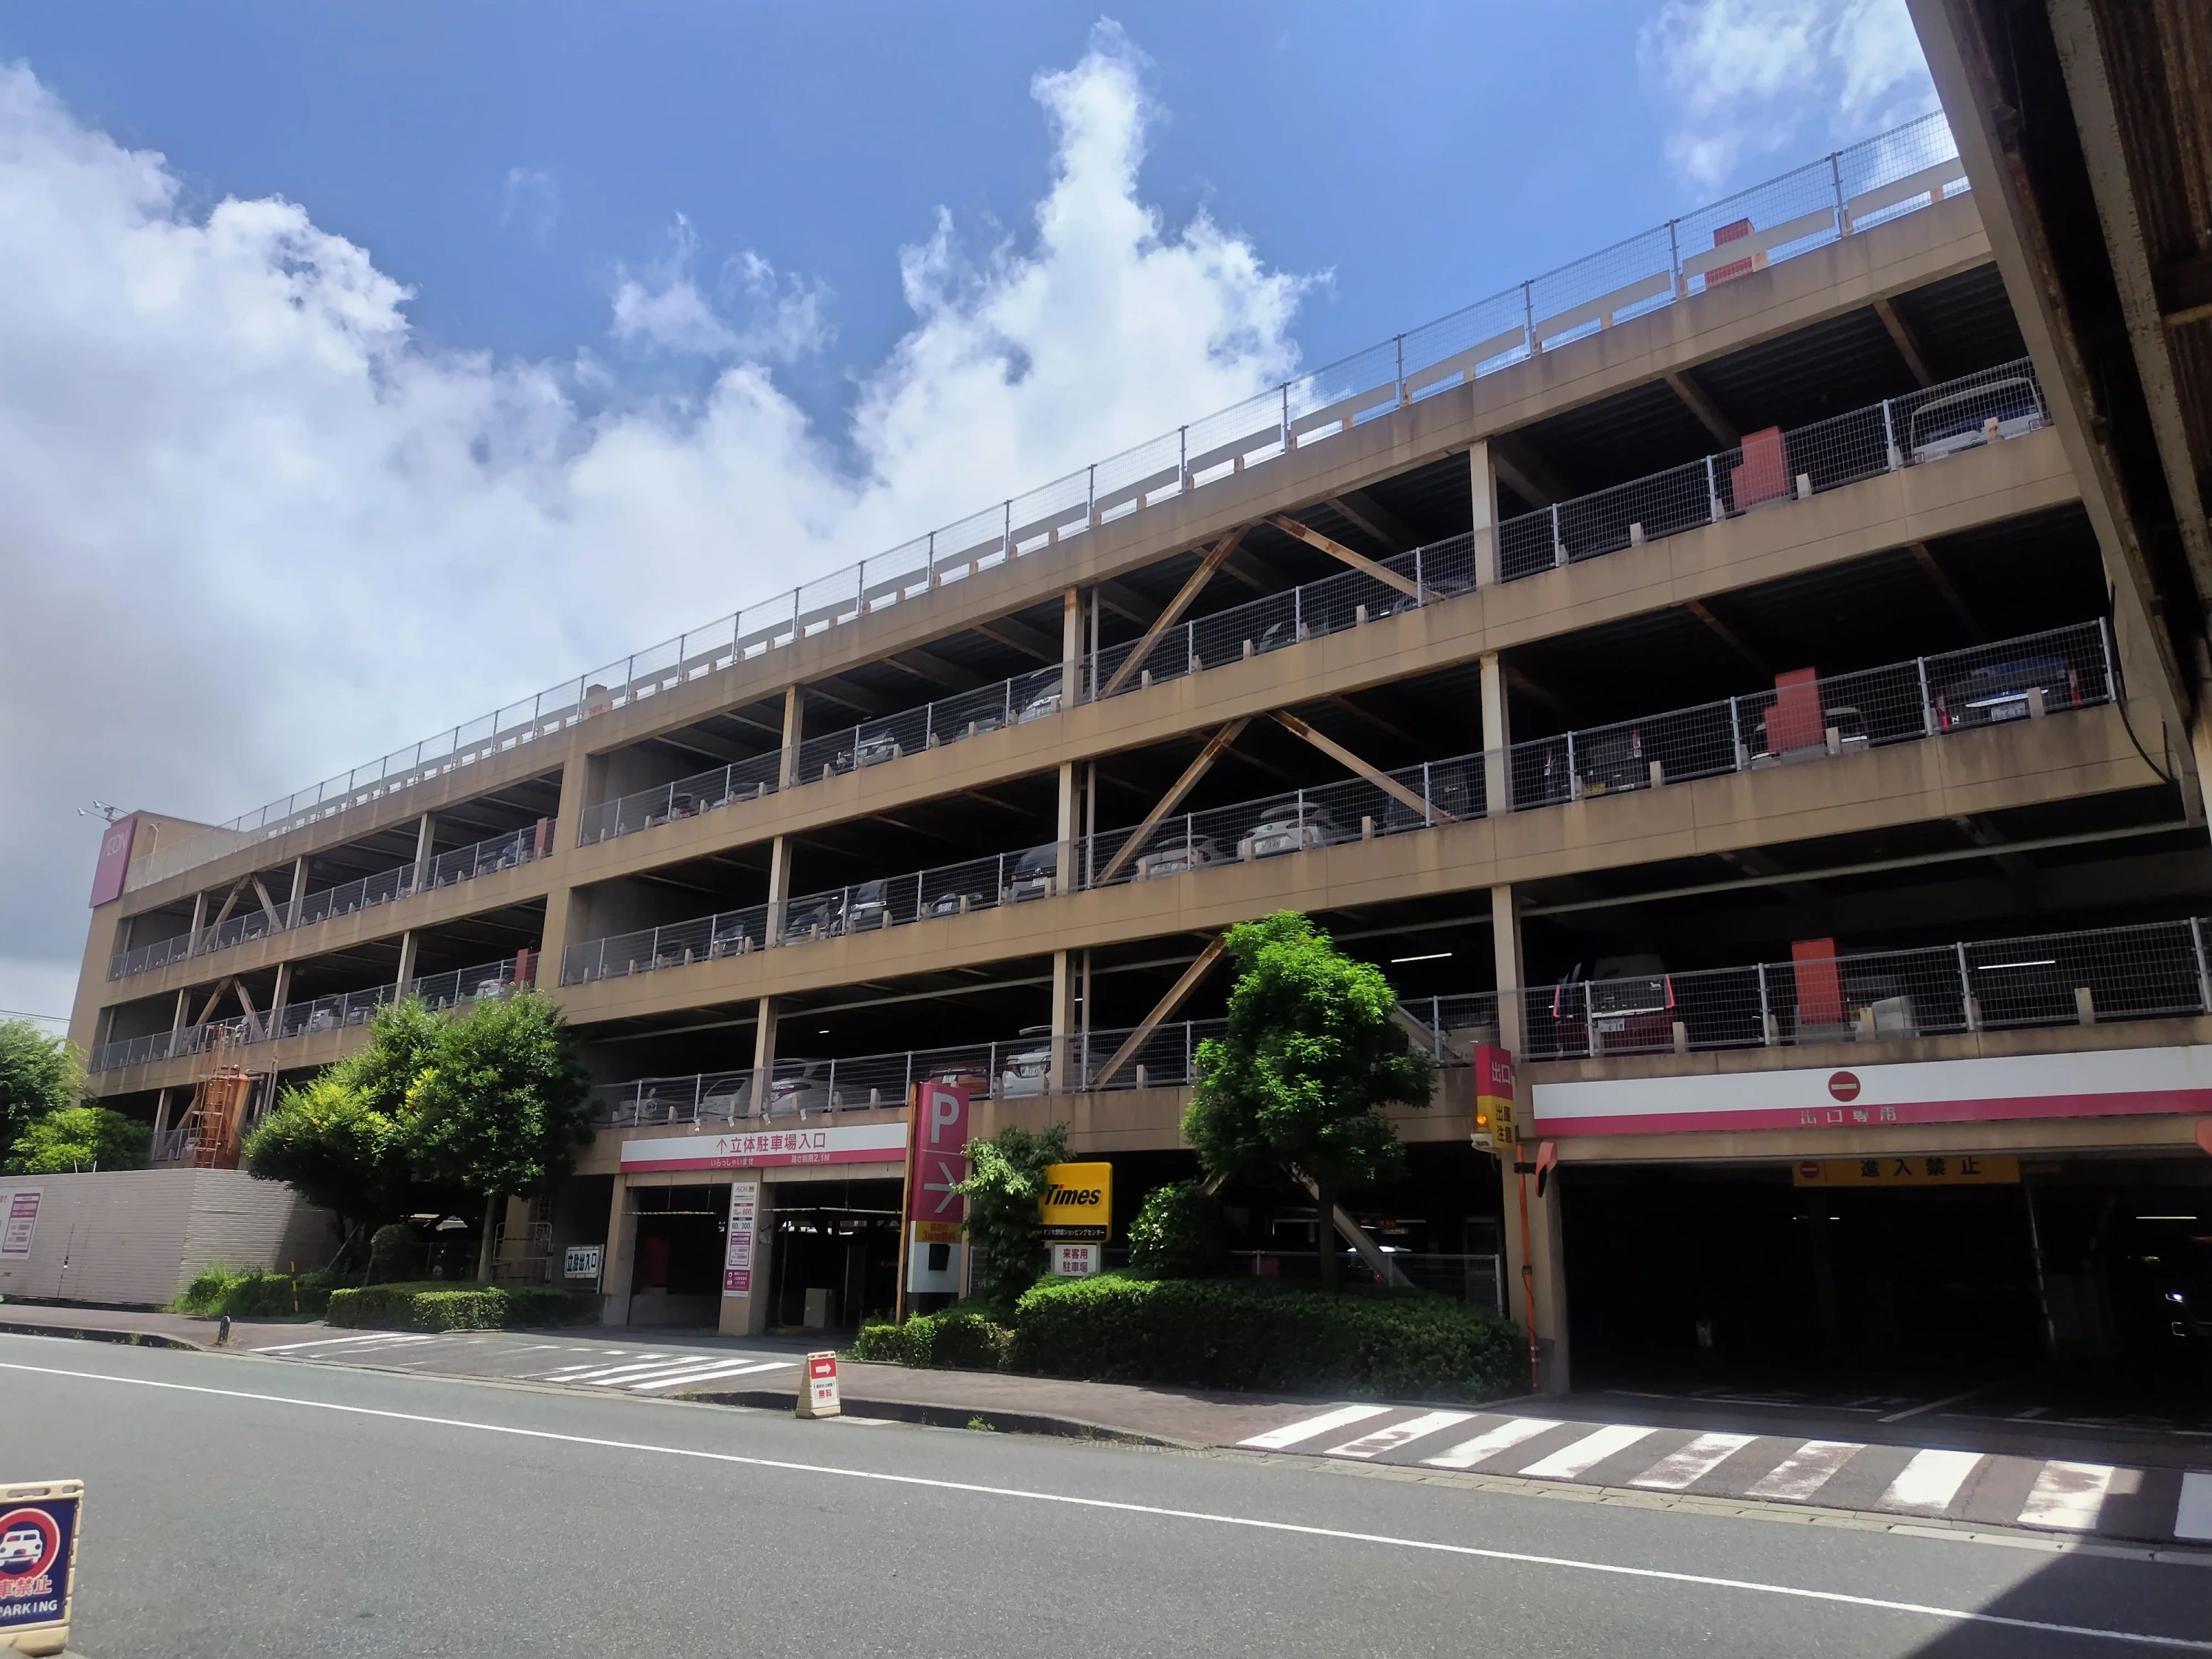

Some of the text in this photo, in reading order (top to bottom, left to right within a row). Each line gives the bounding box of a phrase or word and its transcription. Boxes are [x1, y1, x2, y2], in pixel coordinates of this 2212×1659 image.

[1492, 1062, 1510, 1084] 出口
[931, 1092, 959, 1143] P
[1496, 1105, 1511, 1121] 出庫
[730, 1133, 826, 1153] 立体駐車場入口
[1497, 1125, 1512, 1143] 注意
[710, 1158, 754, 1167] いらっしゃいませ
[1861, 1156, 1981, 1178] 進入禁止
[1044, 1184, 1101, 1206] Times
[1062, 1248, 1088, 1259] 来客用
[1062, 1262, 1088, 1273] 駐車場
